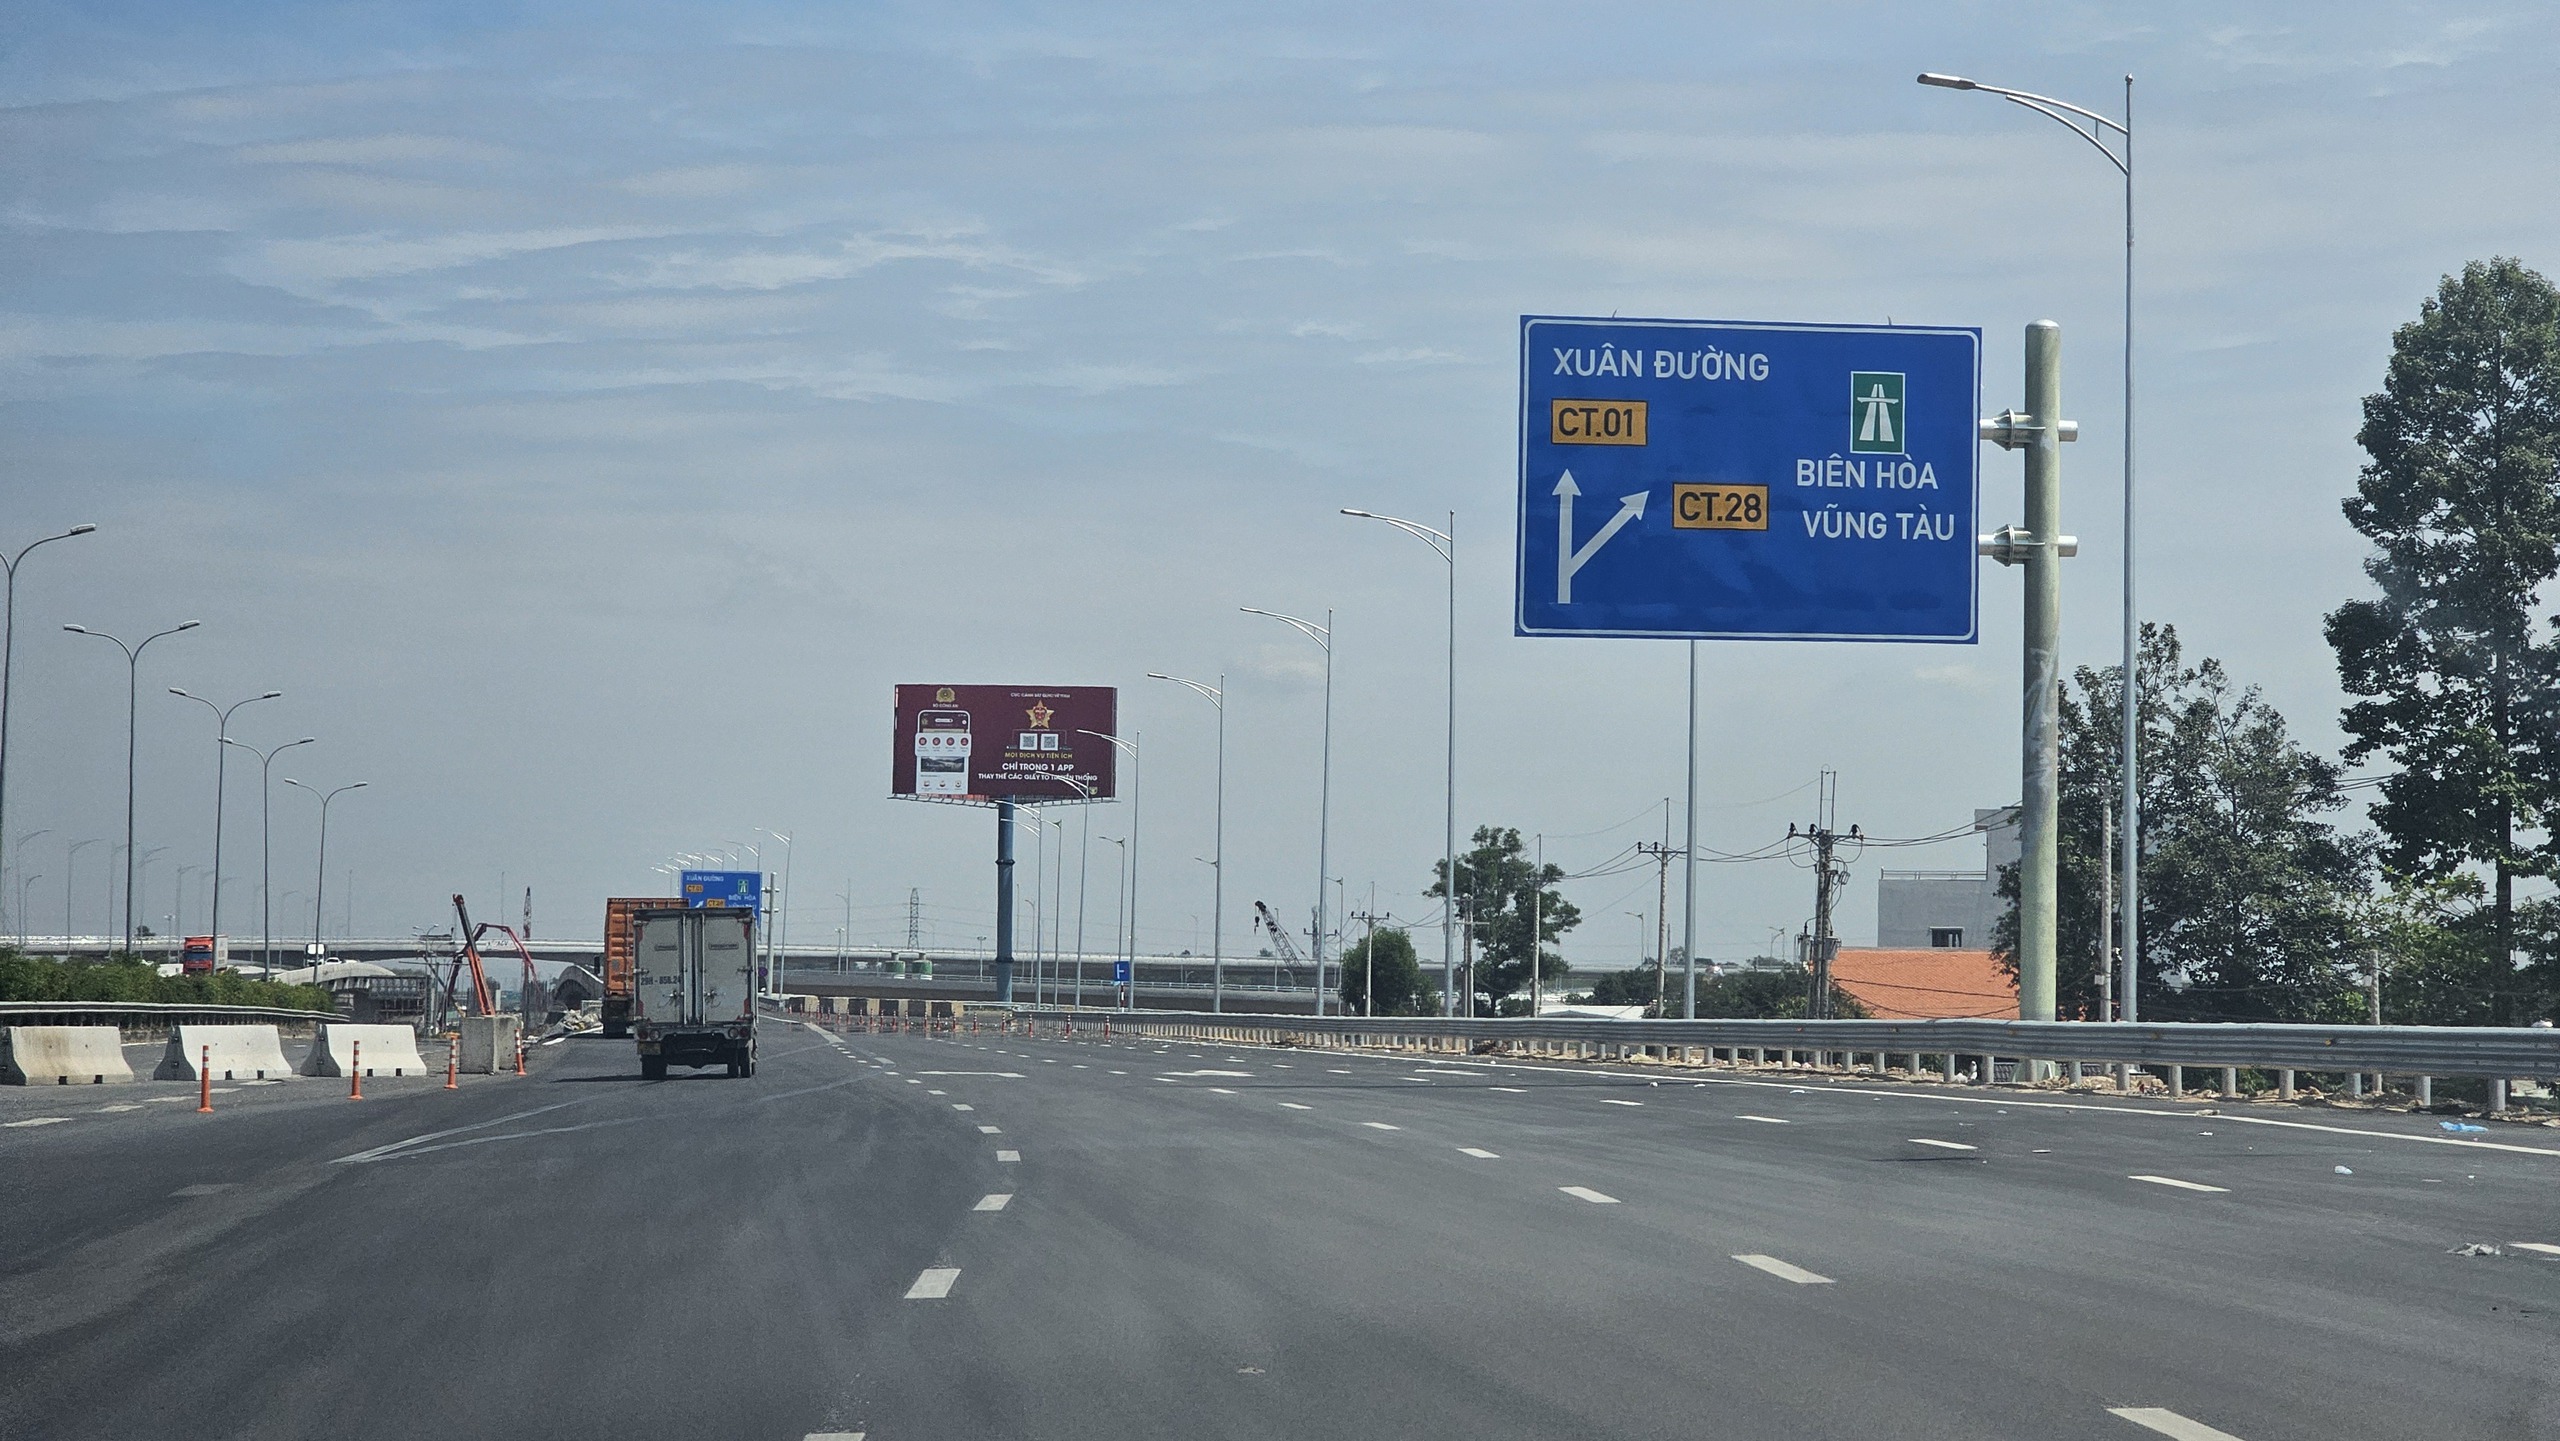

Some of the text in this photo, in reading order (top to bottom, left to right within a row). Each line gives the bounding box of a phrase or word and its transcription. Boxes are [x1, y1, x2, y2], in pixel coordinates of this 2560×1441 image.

[1553, 342, 1770, 381] XUÂN ĐƯỜNG
[1558, 407, 1634, 438] CT.01
[1797, 453, 1939, 490] BIÊN HÒA
[1679, 491, 1762, 523] CT.28
[1803, 503, 1955, 541] VŨNG TÀU
[1002, 761, 1018, 771] CHỈ
[1019, 763, 1049, 771] TRONG
[1057, 763, 1075, 771] APP
[1007, 772, 1023, 780] CÁC
